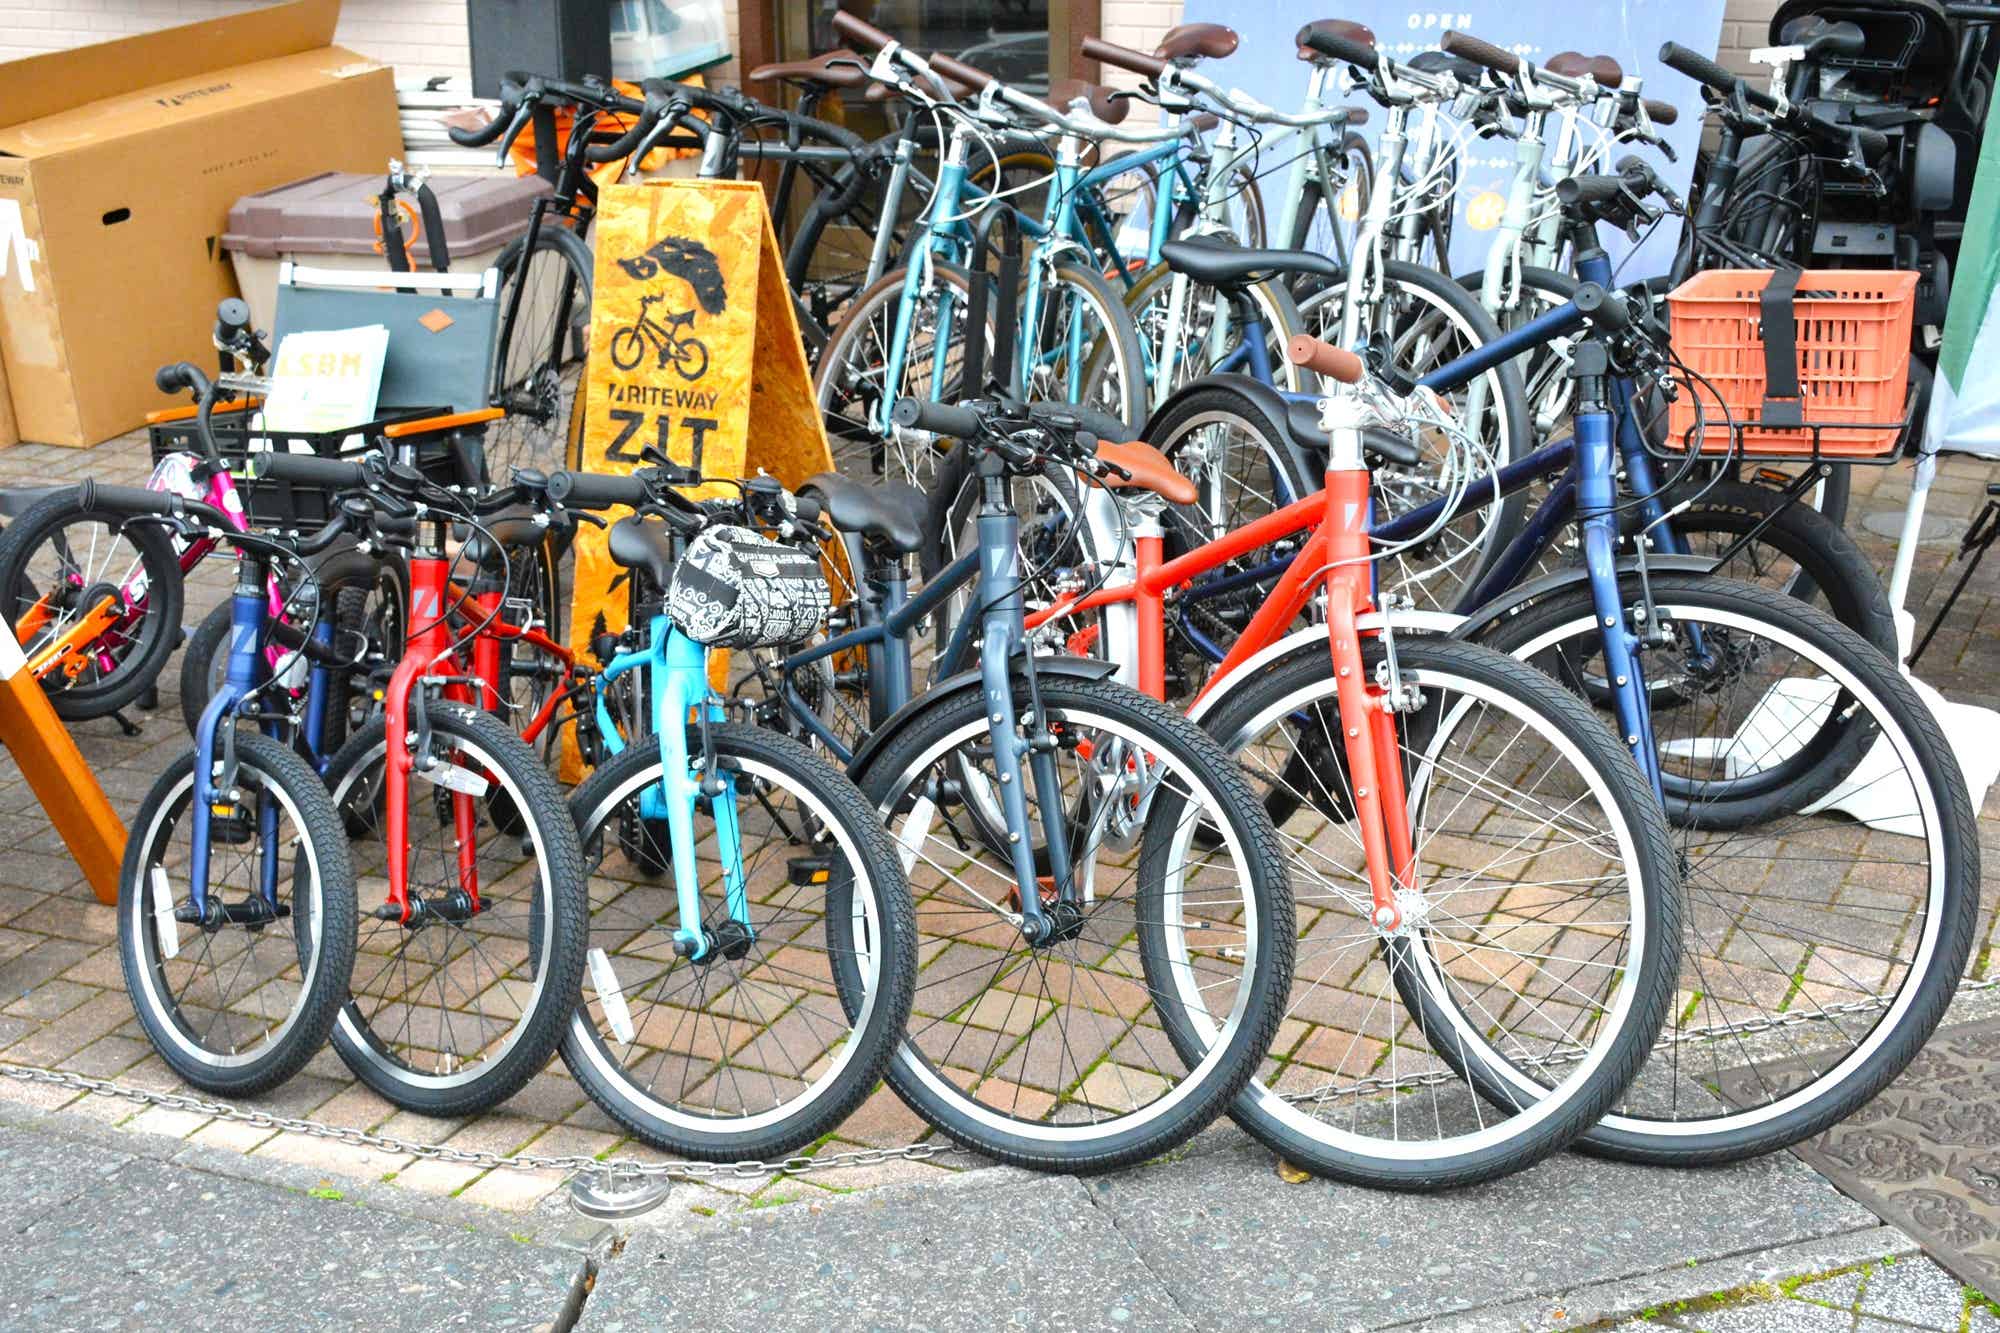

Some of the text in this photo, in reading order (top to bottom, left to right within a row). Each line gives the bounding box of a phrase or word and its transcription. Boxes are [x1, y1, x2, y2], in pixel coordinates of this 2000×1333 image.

[1407, 13, 1473, 29] OPEN
[627, 384, 719, 411] RITEWAY
[605, 408, 719, 470] ZIT
[1690, 503, 1764, 520] ENDA
